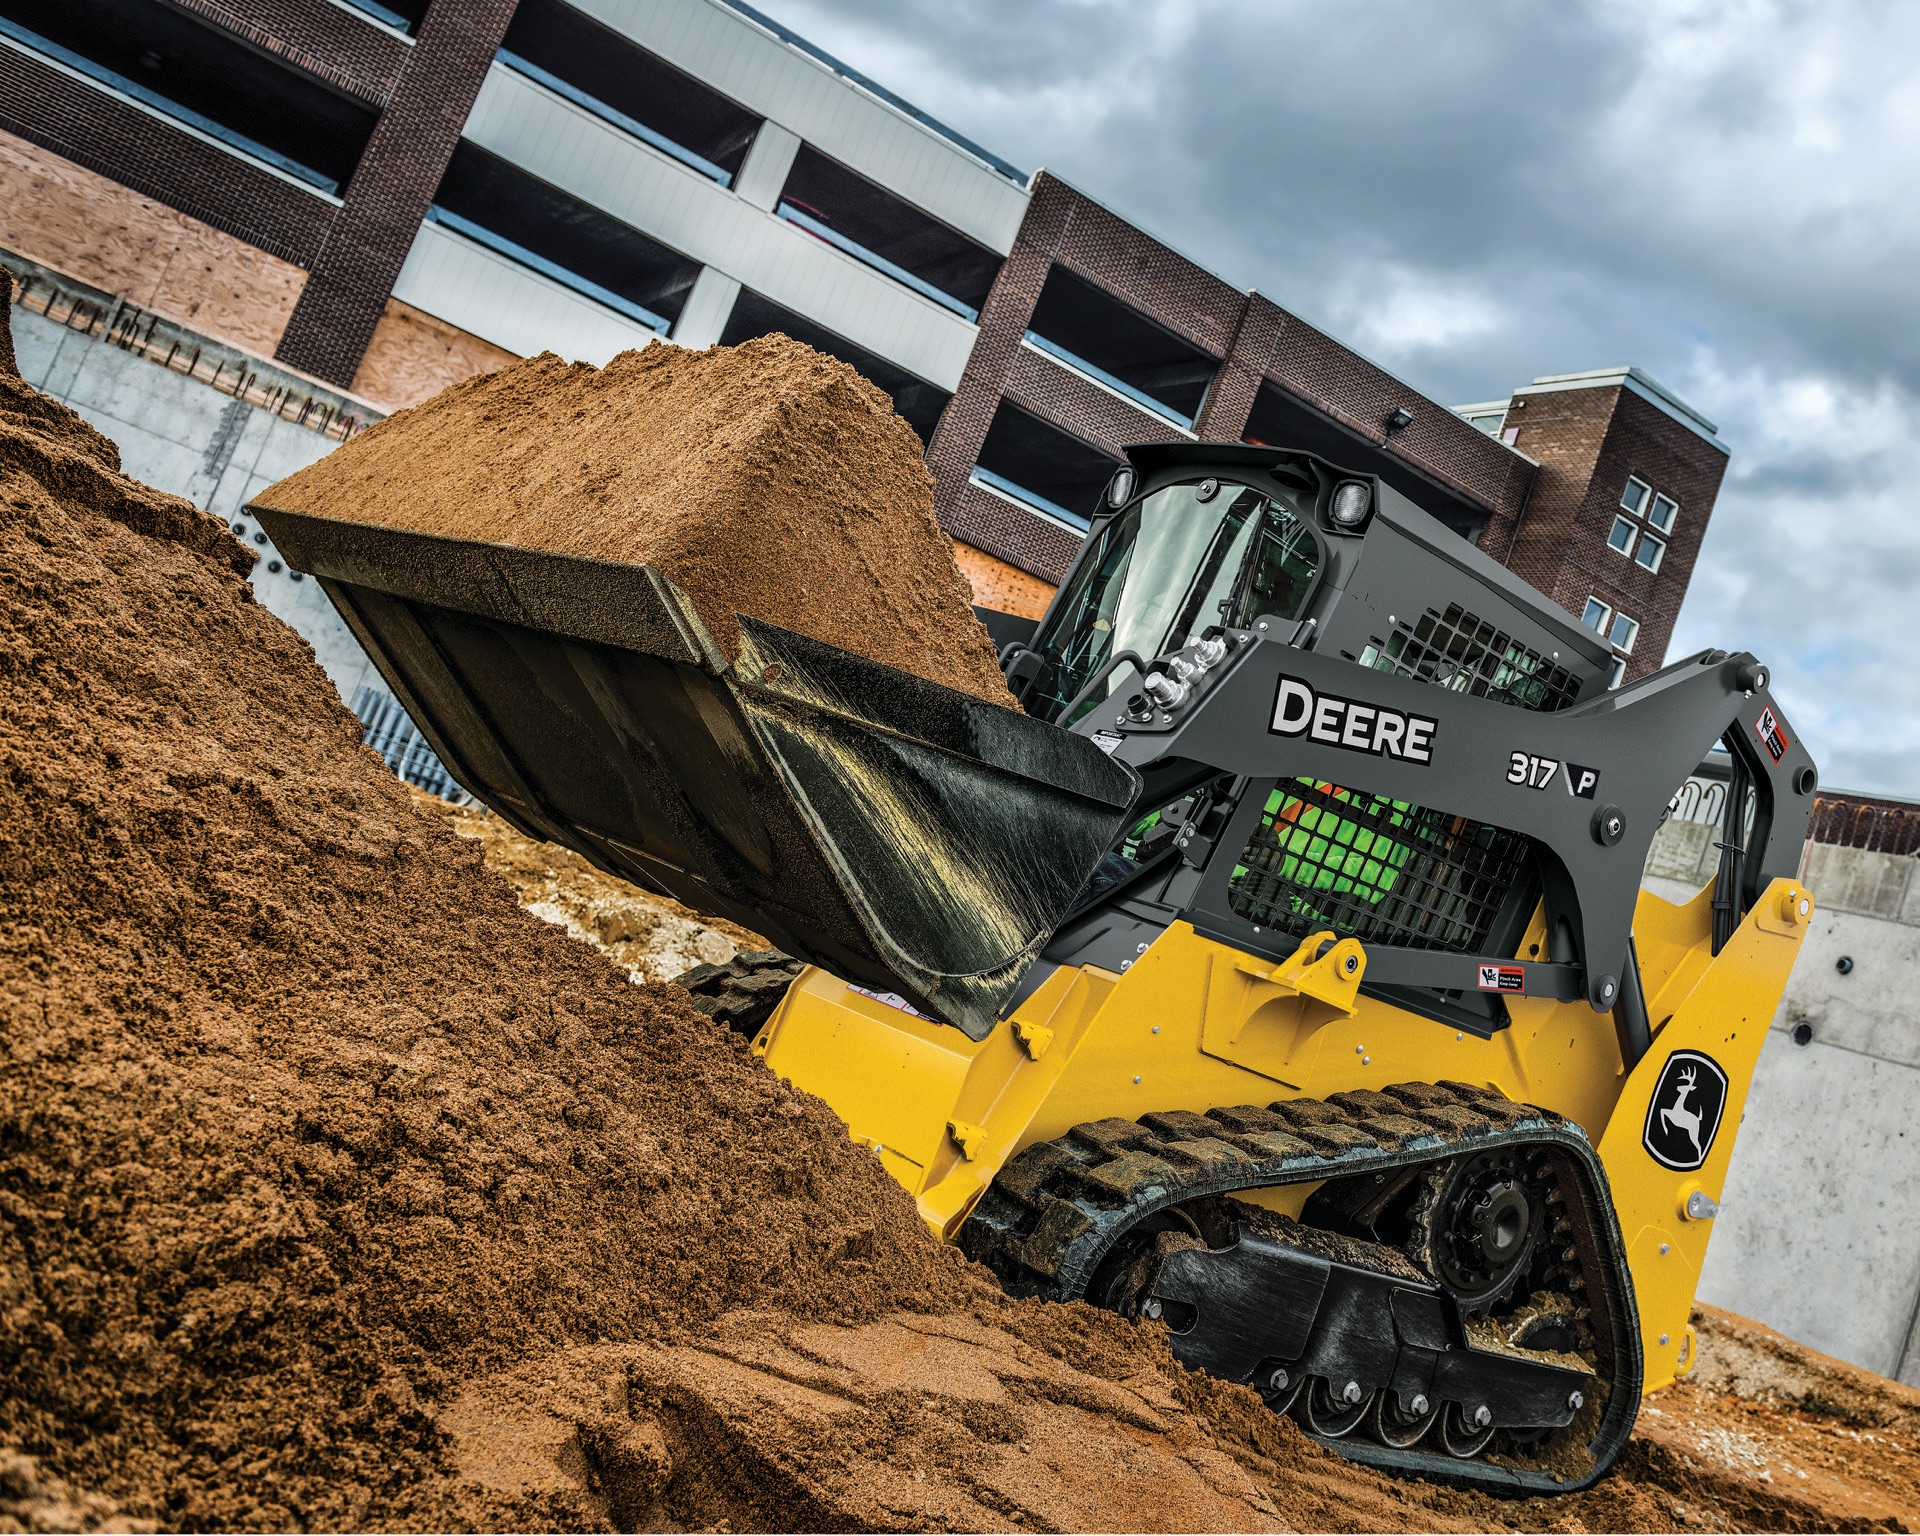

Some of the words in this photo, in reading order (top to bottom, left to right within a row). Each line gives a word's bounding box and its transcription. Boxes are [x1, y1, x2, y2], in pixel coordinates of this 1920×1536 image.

[1271, 678, 1436, 762] DEERE
[1507, 752, 1559, 789] 317
[1576, 770, 1596, 794] P
